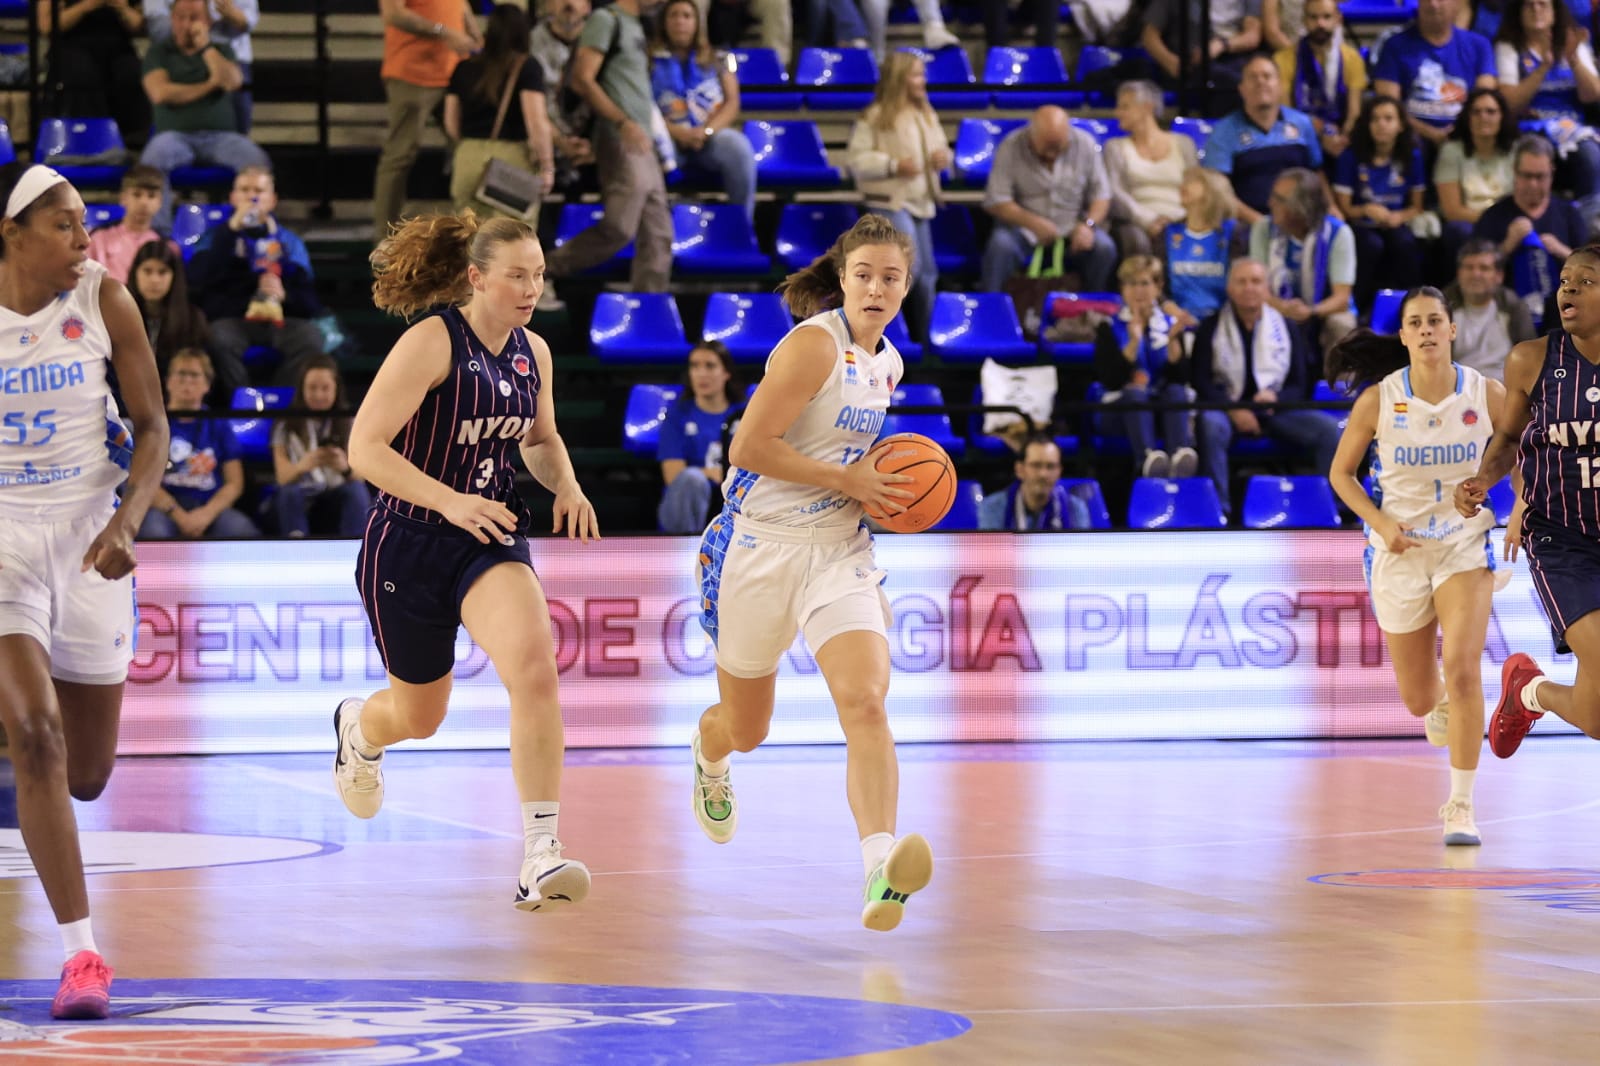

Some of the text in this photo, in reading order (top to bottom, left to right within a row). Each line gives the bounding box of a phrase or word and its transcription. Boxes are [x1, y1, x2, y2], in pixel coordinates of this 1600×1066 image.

[0, 361, 84, 394] ENIDA
[2, 409, 56, 446] 55
[1549, 420, 1600, 447] NY
[1394, 441, 1477, 466] AVENIDA
[476, 457, 494, 489] 3
[1434, 479, 1442, 502] 1
[128, 602, 490, 683] CENT
[662, 574, 1042, 676] CGÍA
[1064, 572, 1511, 671] PLÁSTI
